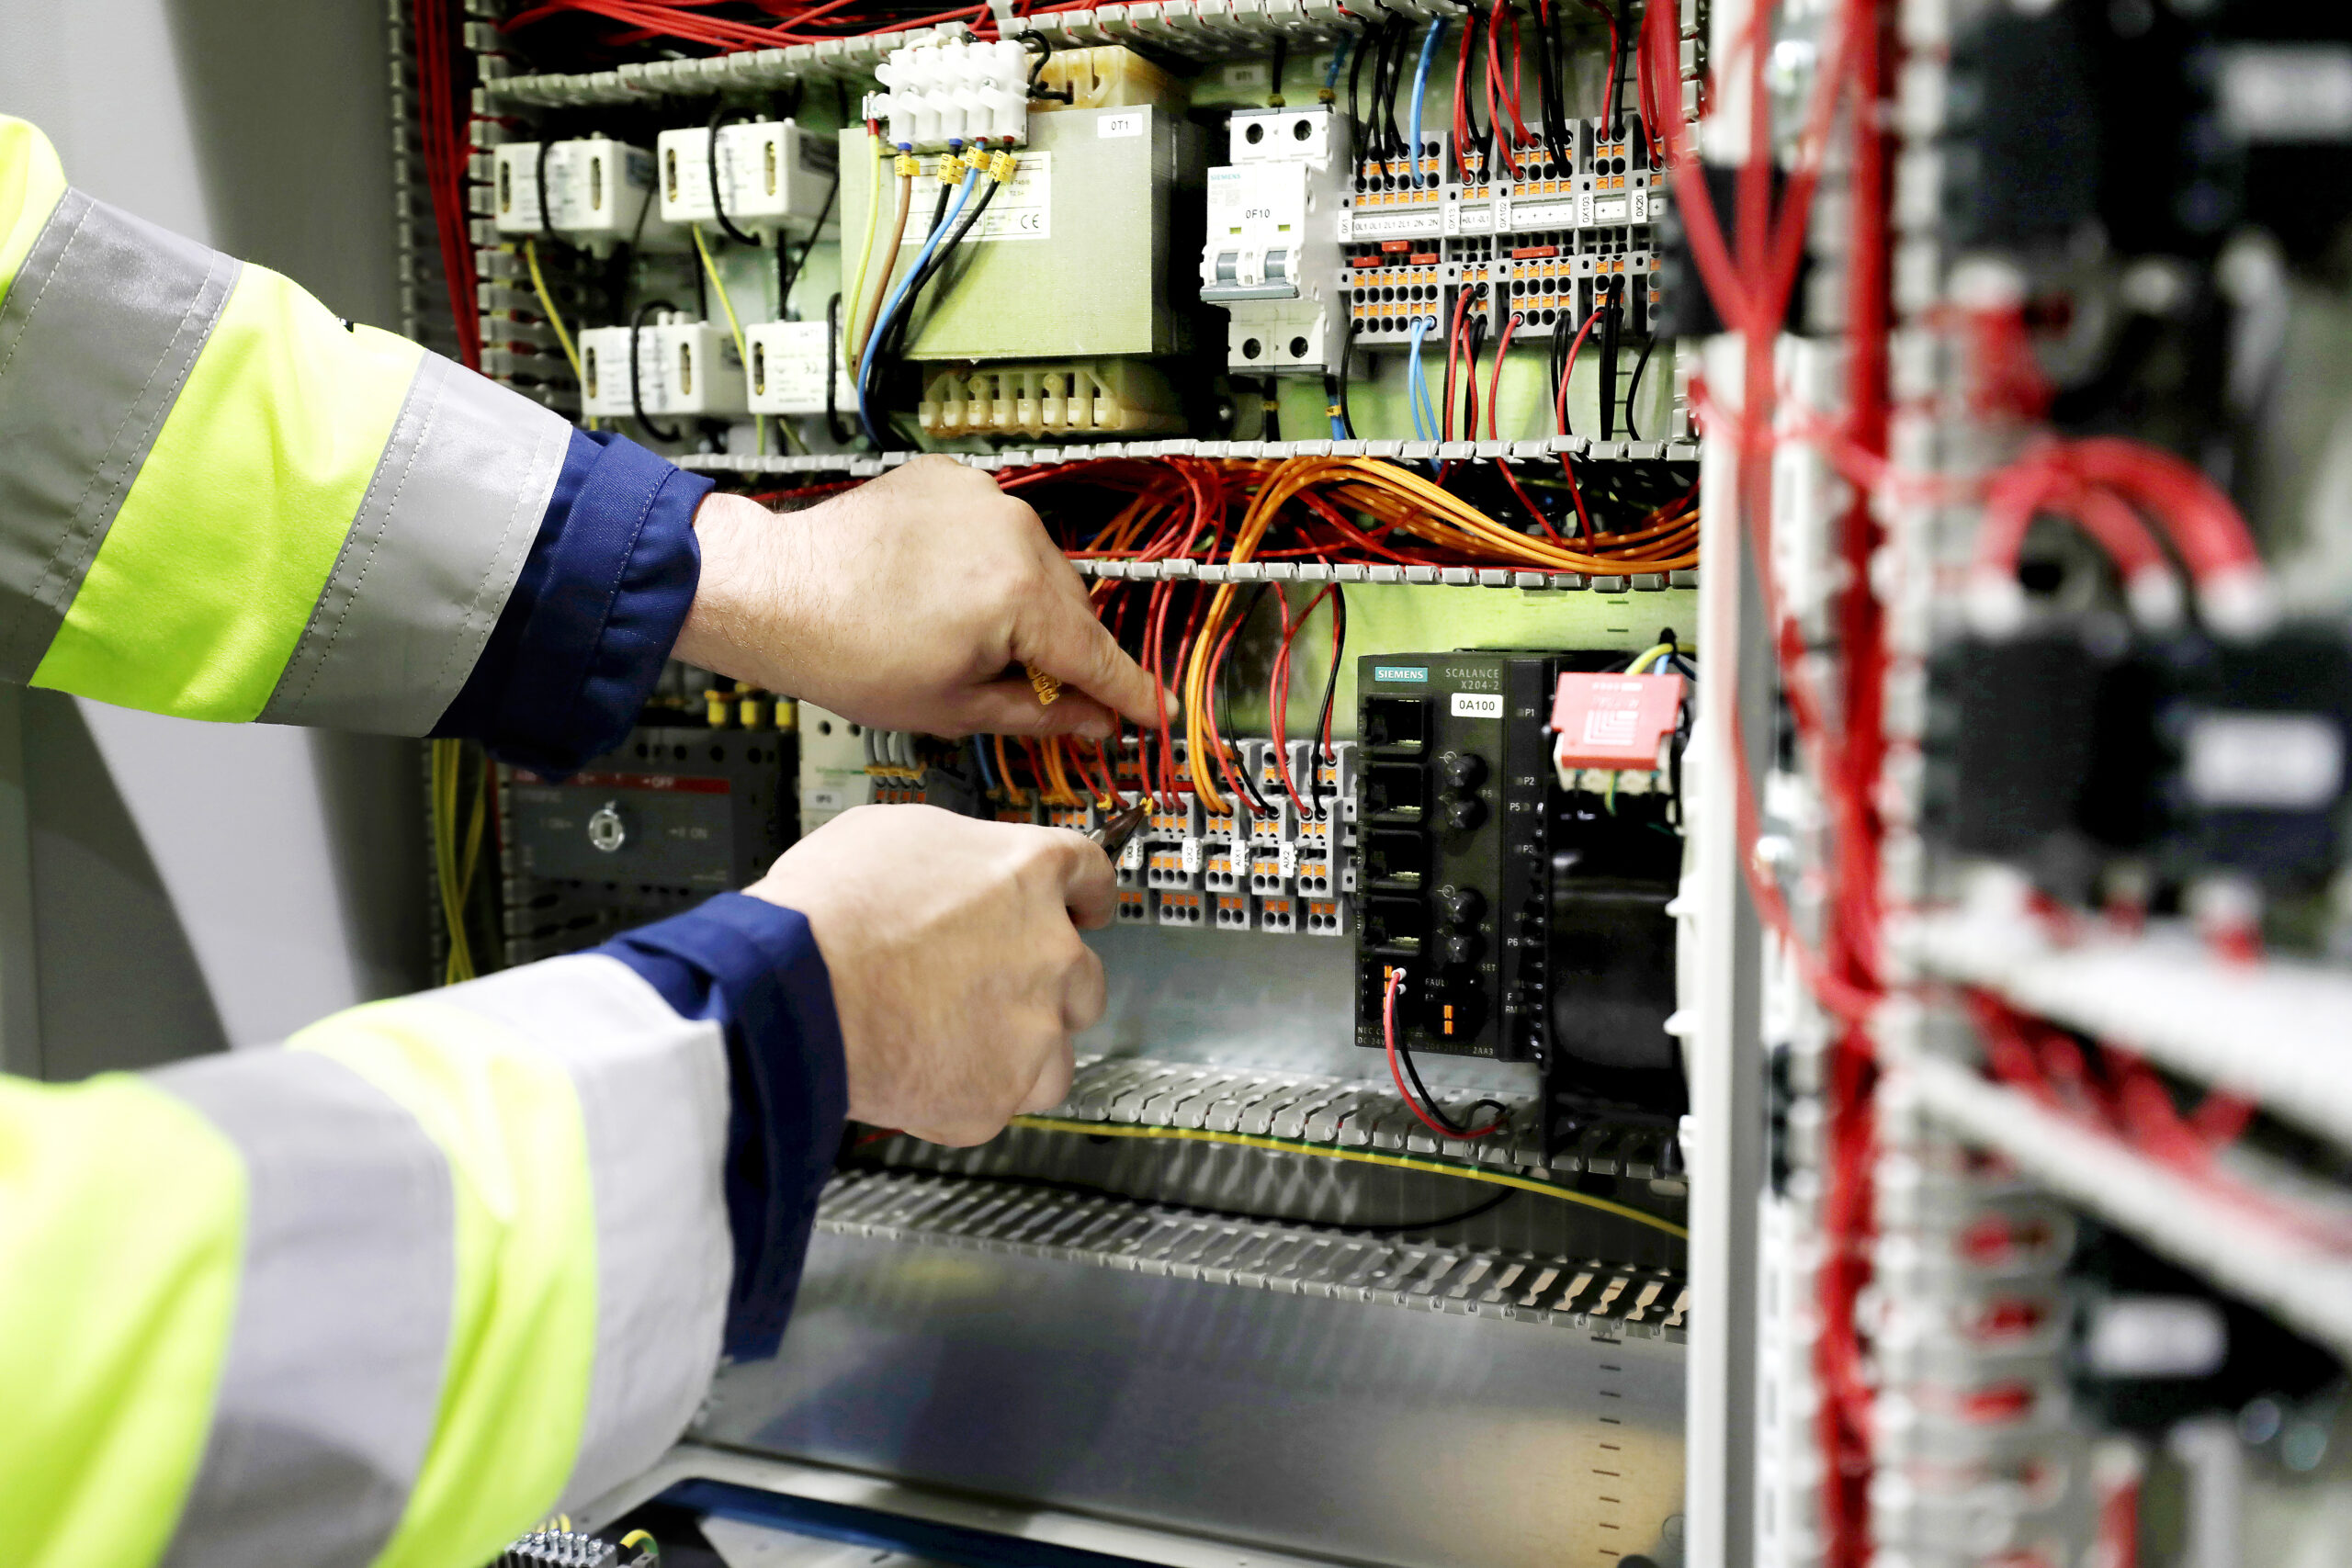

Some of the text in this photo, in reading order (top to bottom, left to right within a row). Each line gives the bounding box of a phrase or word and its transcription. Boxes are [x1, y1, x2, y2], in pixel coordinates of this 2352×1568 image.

[1245, 209, 1271, 219] 0F10
[1378, 670, 1424, 680] SIEMENS
[1445, 669, 1499, 679] SCALANCE
[1461, 680, 1499, 690] X204-2
[1459, 700, 1496, 711] 0A100
[1524, 708, 1534, 717] P1
[1524, 777, 1535, 785] P2
[1510, 802, 1521, 811] P5
[1507, 938, 1519, 947] P6
[1482, 963, 1496, 972] SET
